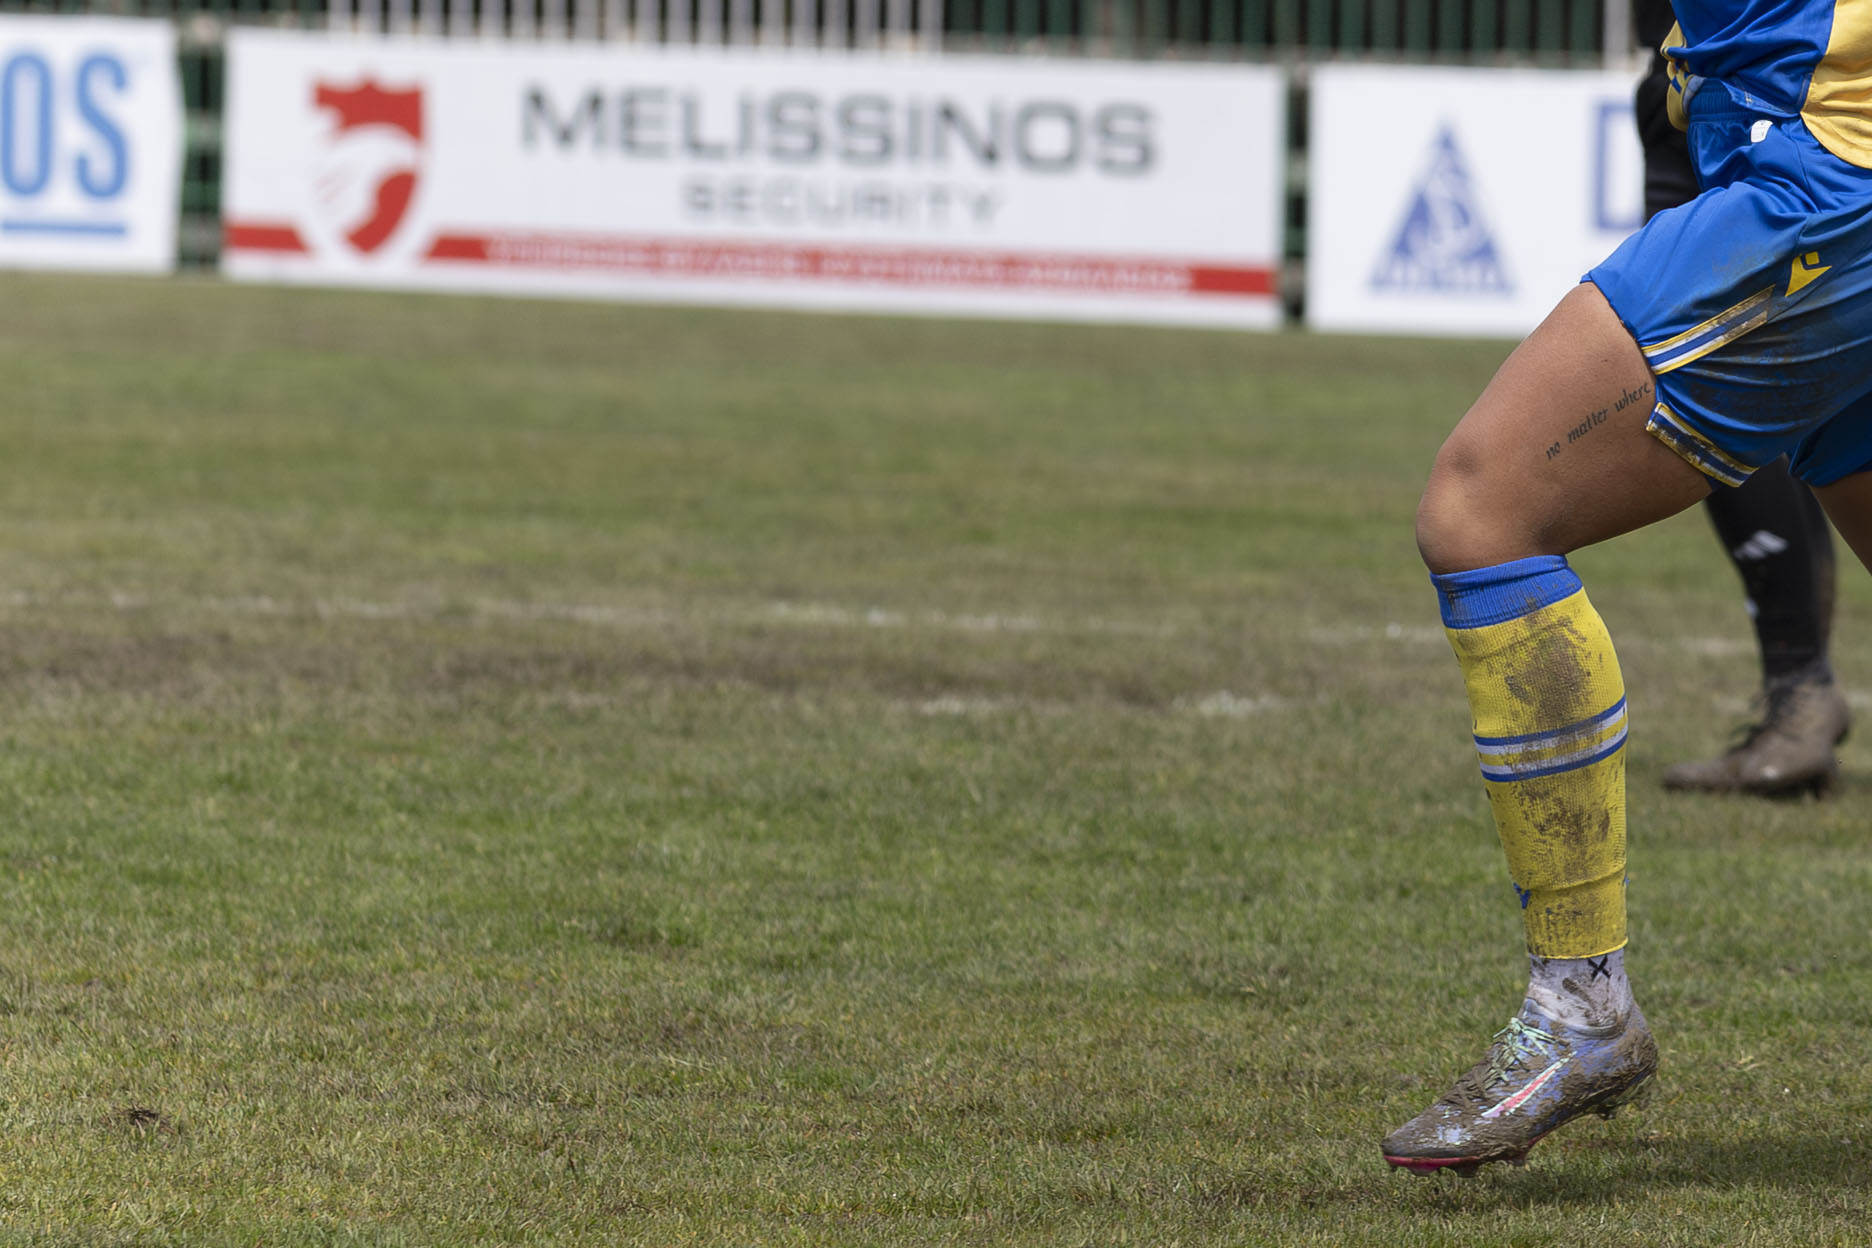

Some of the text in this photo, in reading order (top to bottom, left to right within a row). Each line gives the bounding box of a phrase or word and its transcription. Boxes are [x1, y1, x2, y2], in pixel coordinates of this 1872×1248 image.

[523, 84, 1156, 176] MELISSINOS
[684, 178, 1000, 228] SECURITY
[1546, 383, 1651, 460] no matter where
